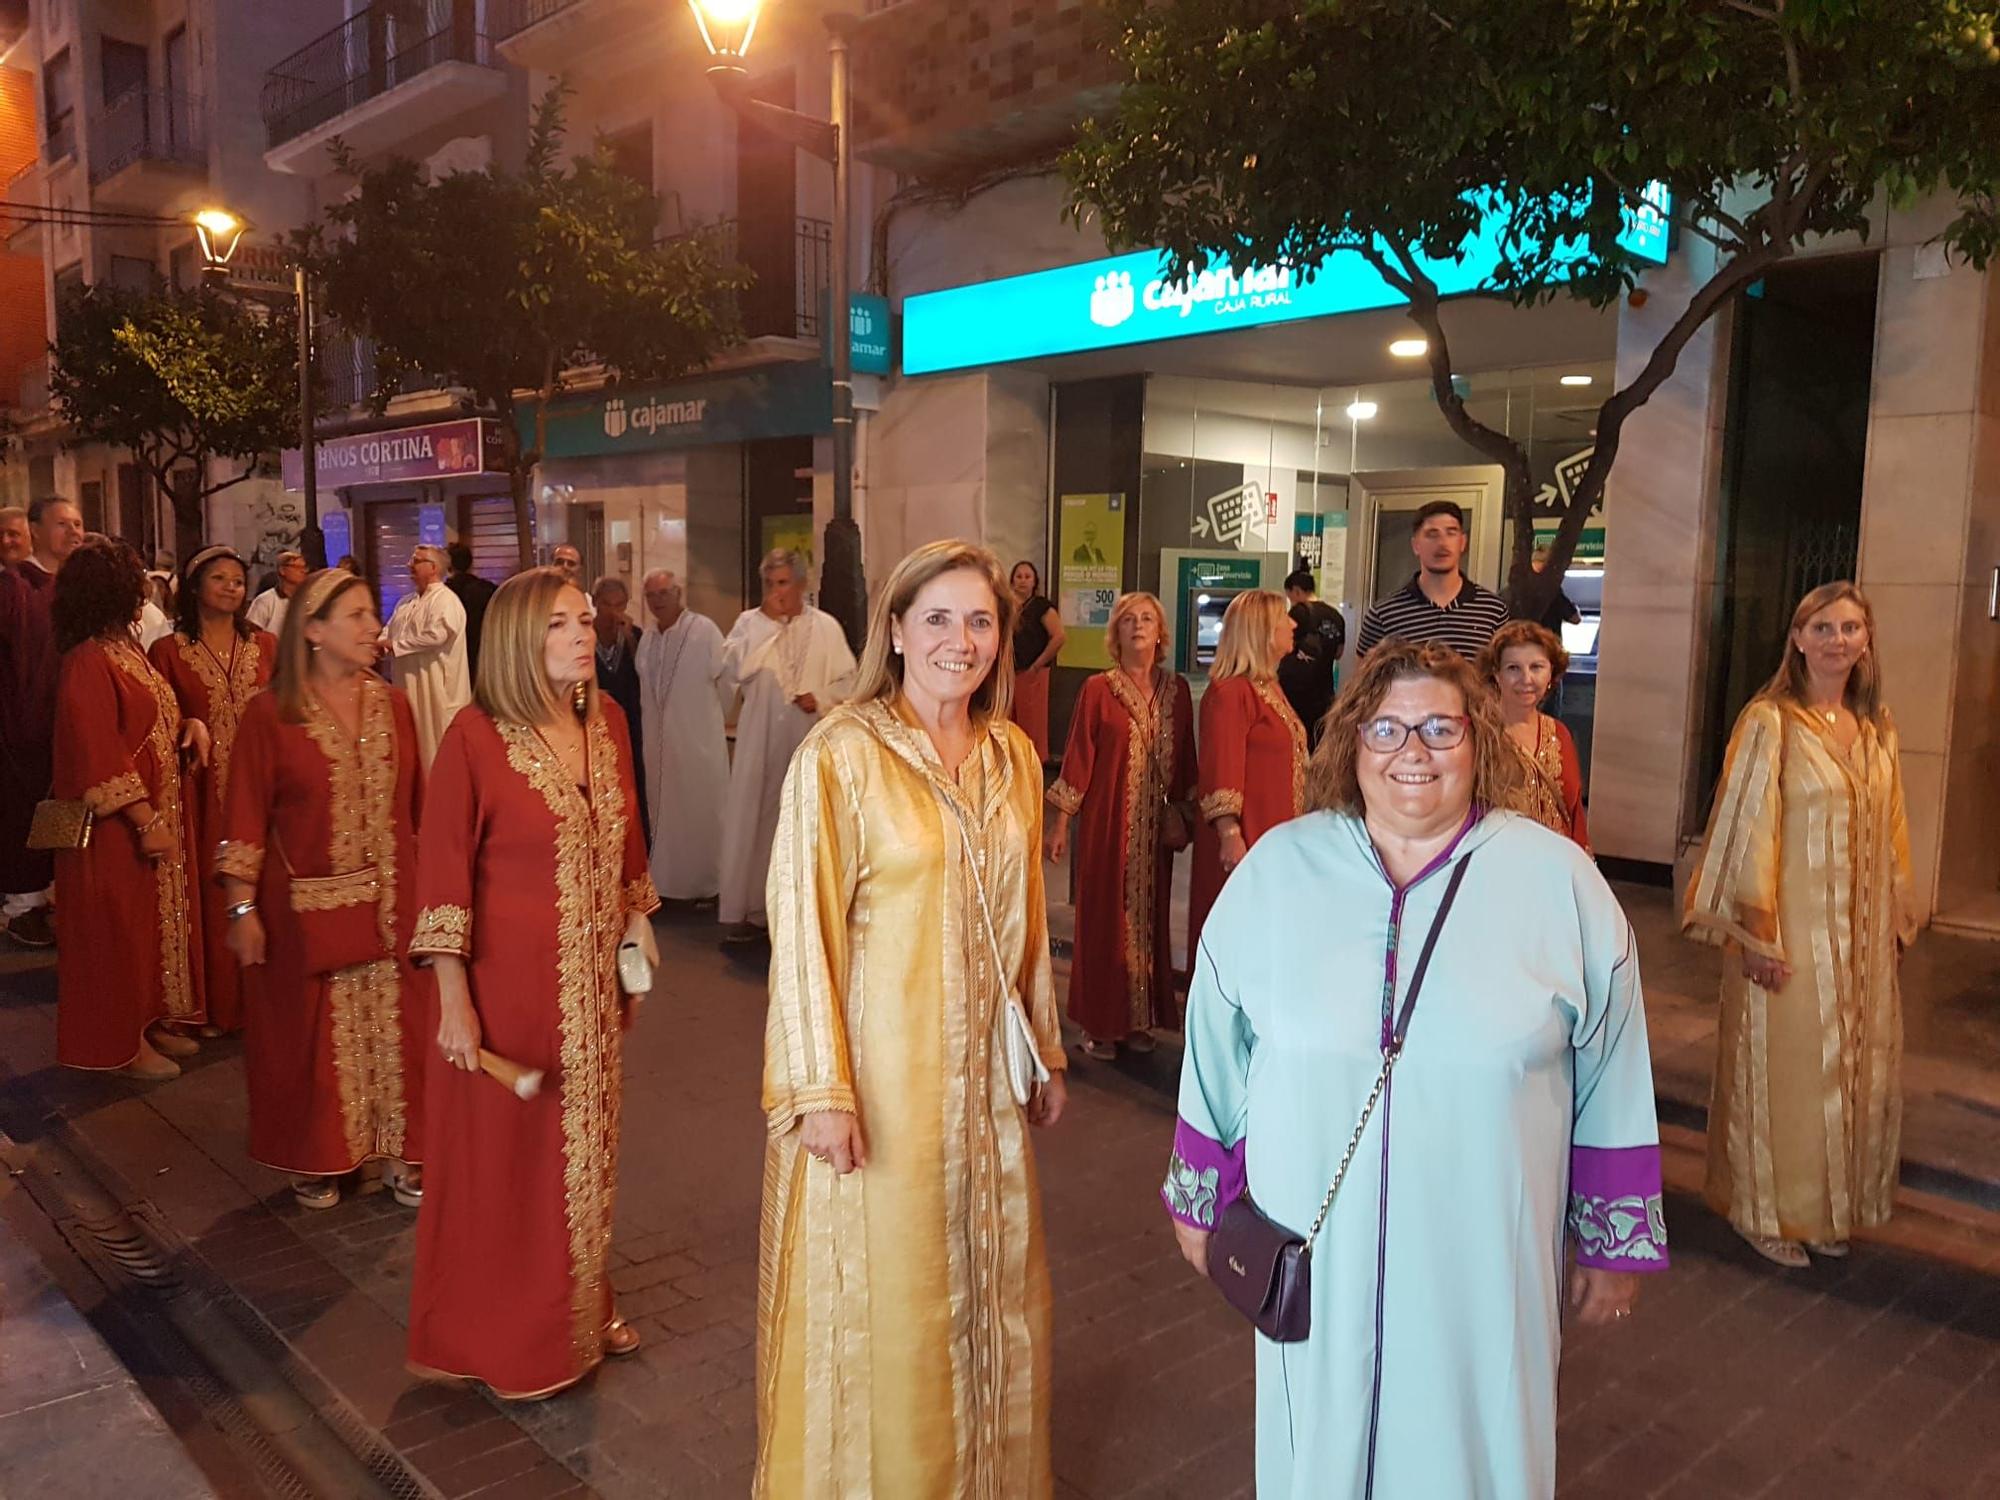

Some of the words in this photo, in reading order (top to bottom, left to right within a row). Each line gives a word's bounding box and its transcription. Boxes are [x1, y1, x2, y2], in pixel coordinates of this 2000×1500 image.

[1215, 300, 1247, 315] CAJA
[1250, 293, 1292, 309] RURAL
[851, 341, 887, 356] amar
[630, 397, 706, 435] cajamar
[318, 446, 357, 470] HNOS
[360, 435, 433, 465] CORTINA
[1095, 590, 1114, 604] 500
